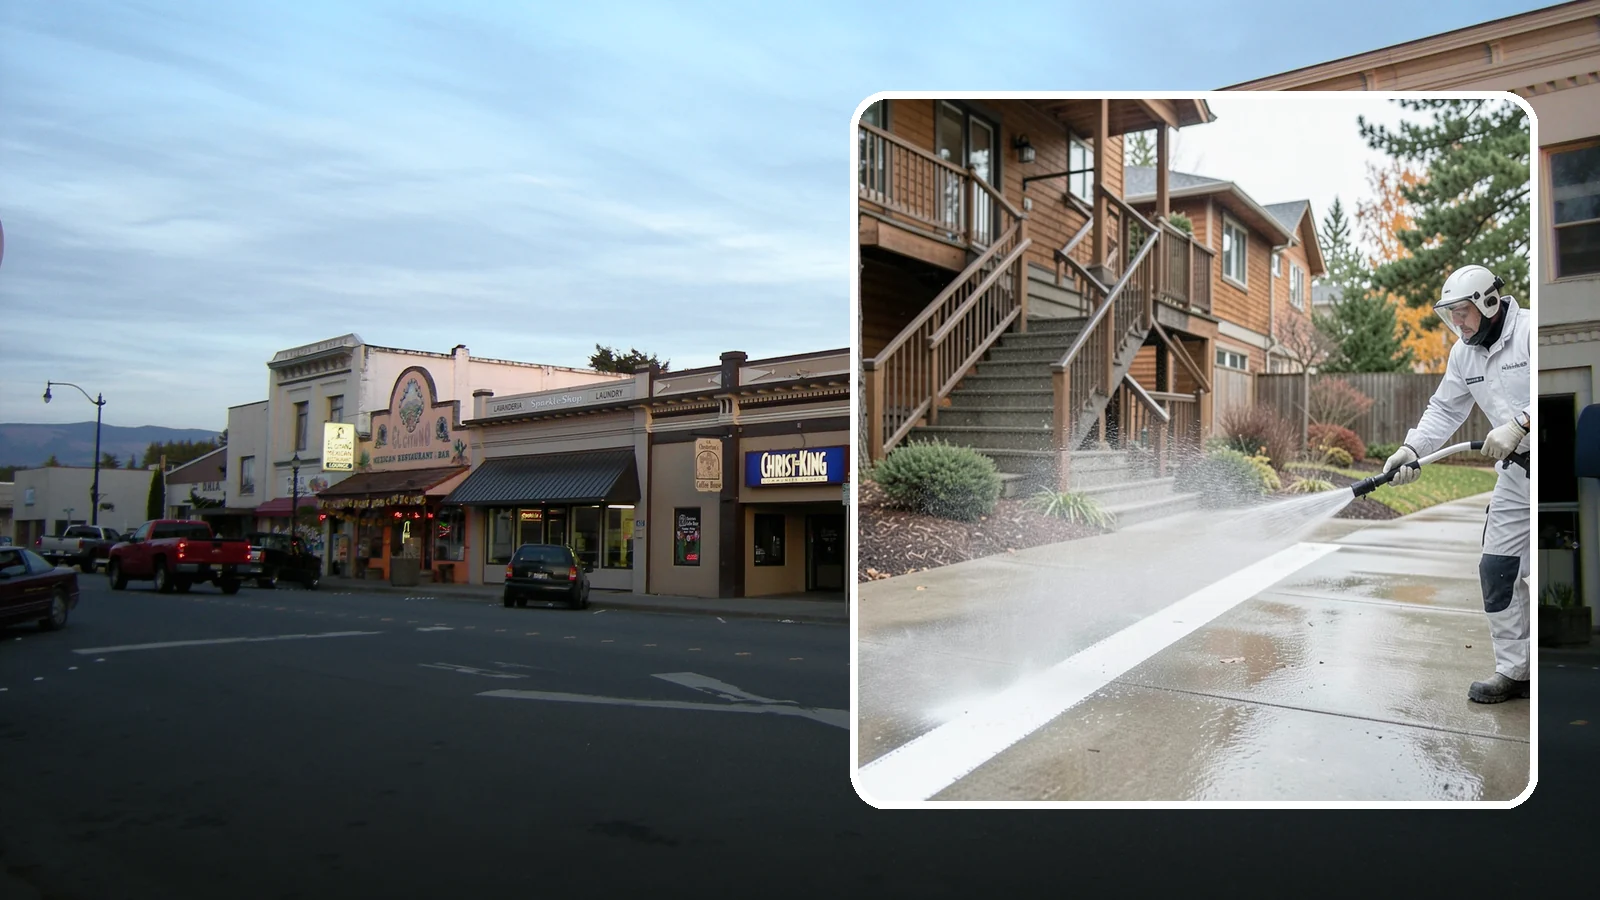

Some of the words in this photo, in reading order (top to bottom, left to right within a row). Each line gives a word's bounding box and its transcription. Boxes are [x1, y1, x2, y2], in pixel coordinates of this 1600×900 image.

[531, 396, 560, 408] Sparkle
[562, 394, 582, 405] Shop
[596, 390, 623, 400] LAUNDRY
[494, 402, 522, 412] LAVANDERIA
[374, 455, 396, 464] MEXICAN
[398, 452, 433, 462] RESTAURANT
[438, 450, 450, 458] BAR
[799, 450, 827, 476] KING
[697, 481, 709, 489] Coffee
